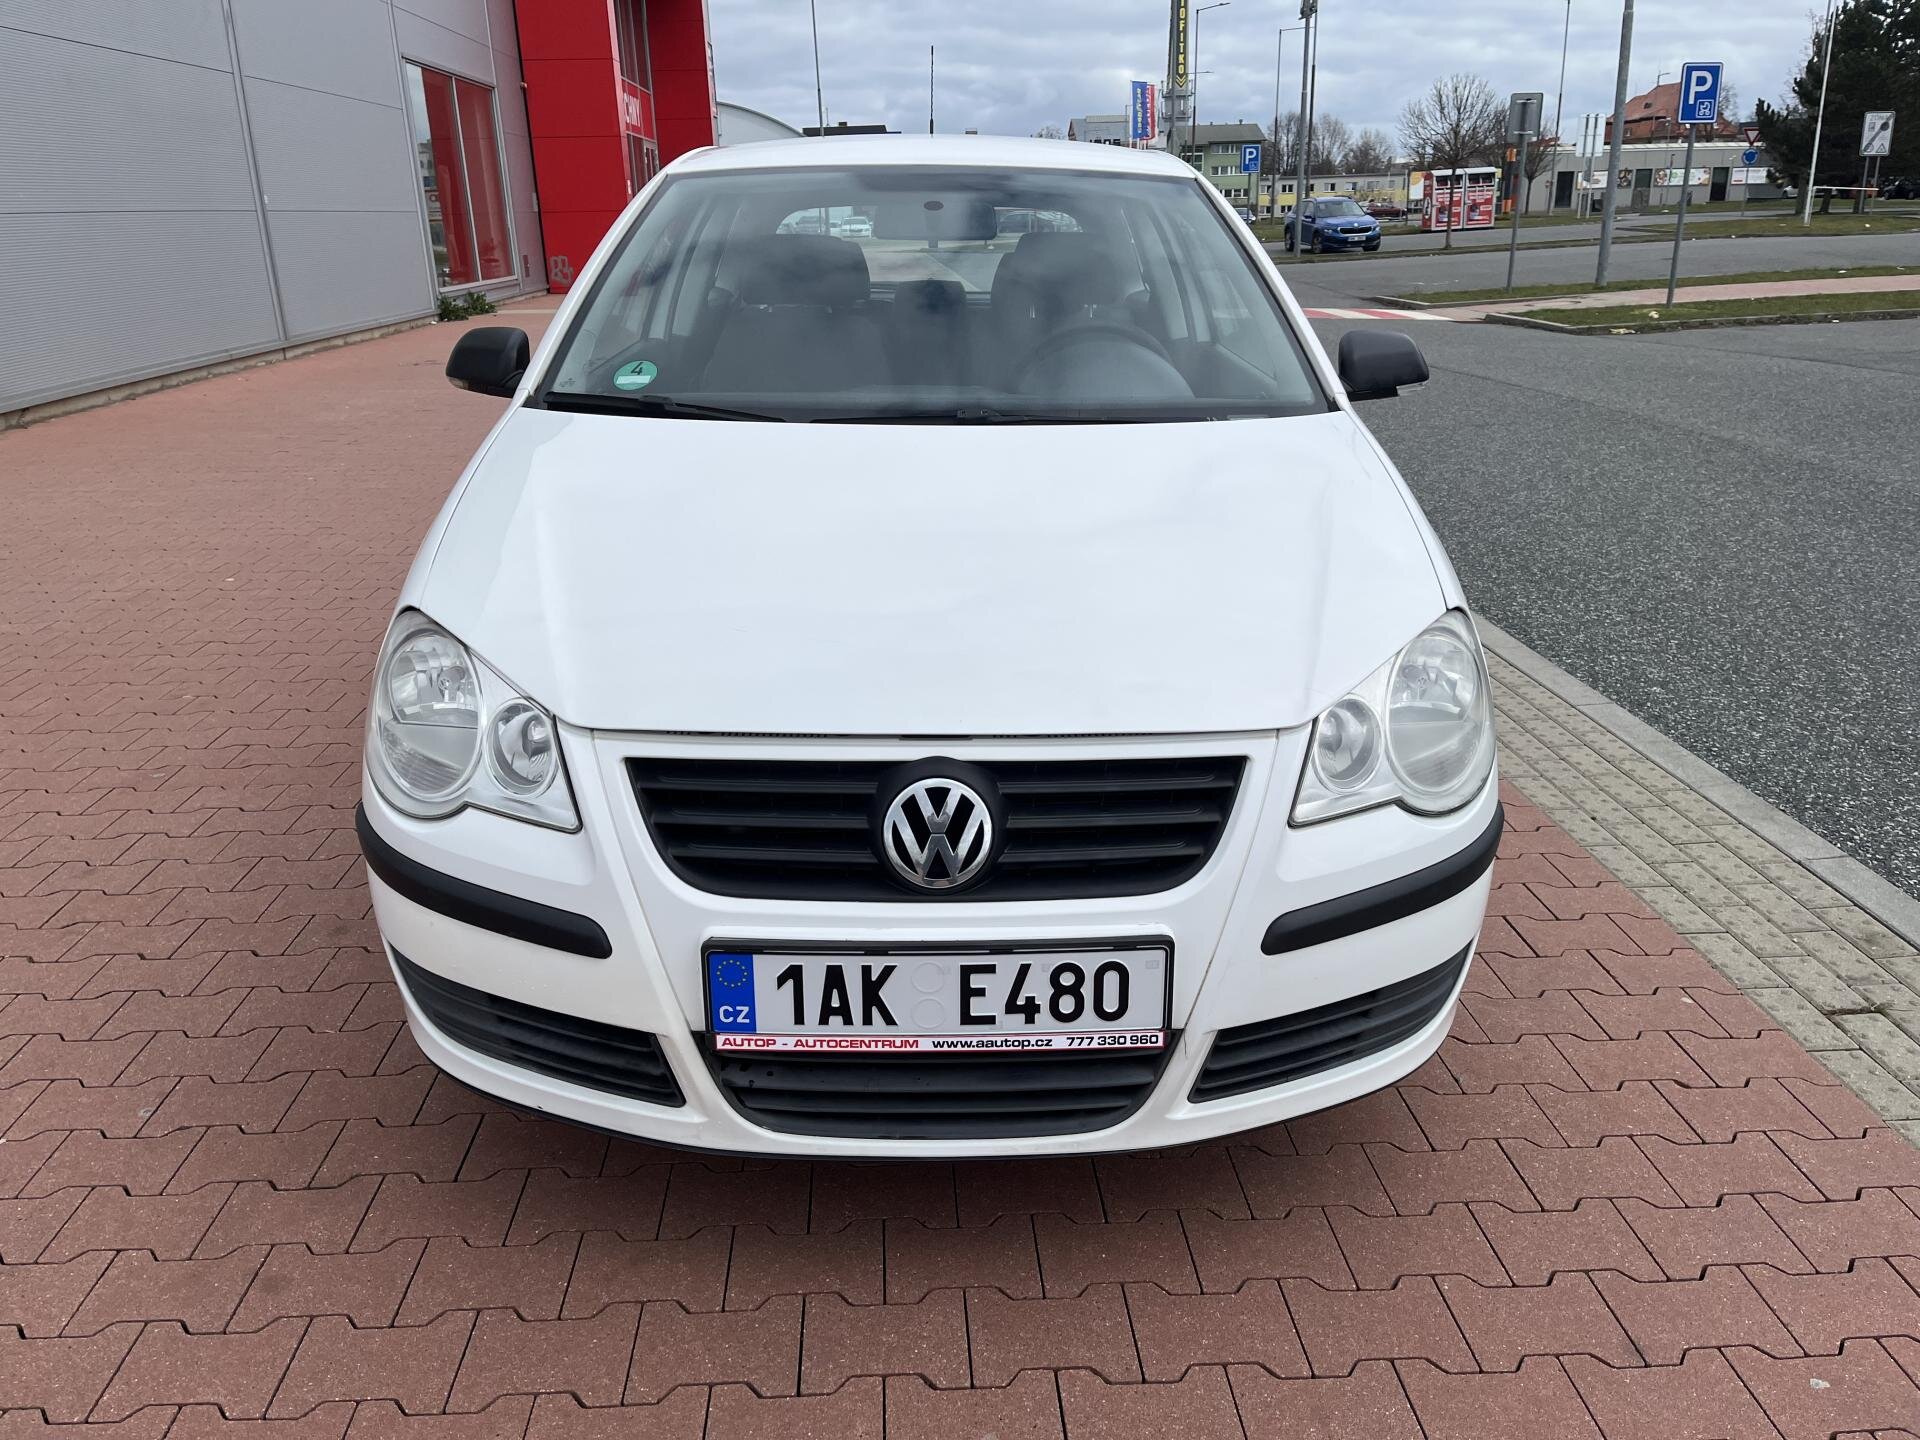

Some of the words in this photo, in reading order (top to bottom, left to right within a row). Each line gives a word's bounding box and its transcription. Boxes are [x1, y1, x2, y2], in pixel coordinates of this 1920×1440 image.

[1688, 70, 1713, 105] P
[1245, 148, 1257, 165] P
[630, 361, 644, 376] 4
[883, 777, 993, 889] VW
[776, 964, 899, 1026] 1AK
[959, 960, 1130, 1026] E480
[719, 1005, 750, 1024] CZ
[721, 1037, 777, 1048] AUTOP
[793, 1039, 919, 1049] AUTOCENTRUM
[931, 1037, 1053, 1050] www.aautop.cz
[1066, 1036, 1095, 1047] 777
[1097, 1035, 1127, 1046] 330
[1129, 1034, 1159, 1045] 960
